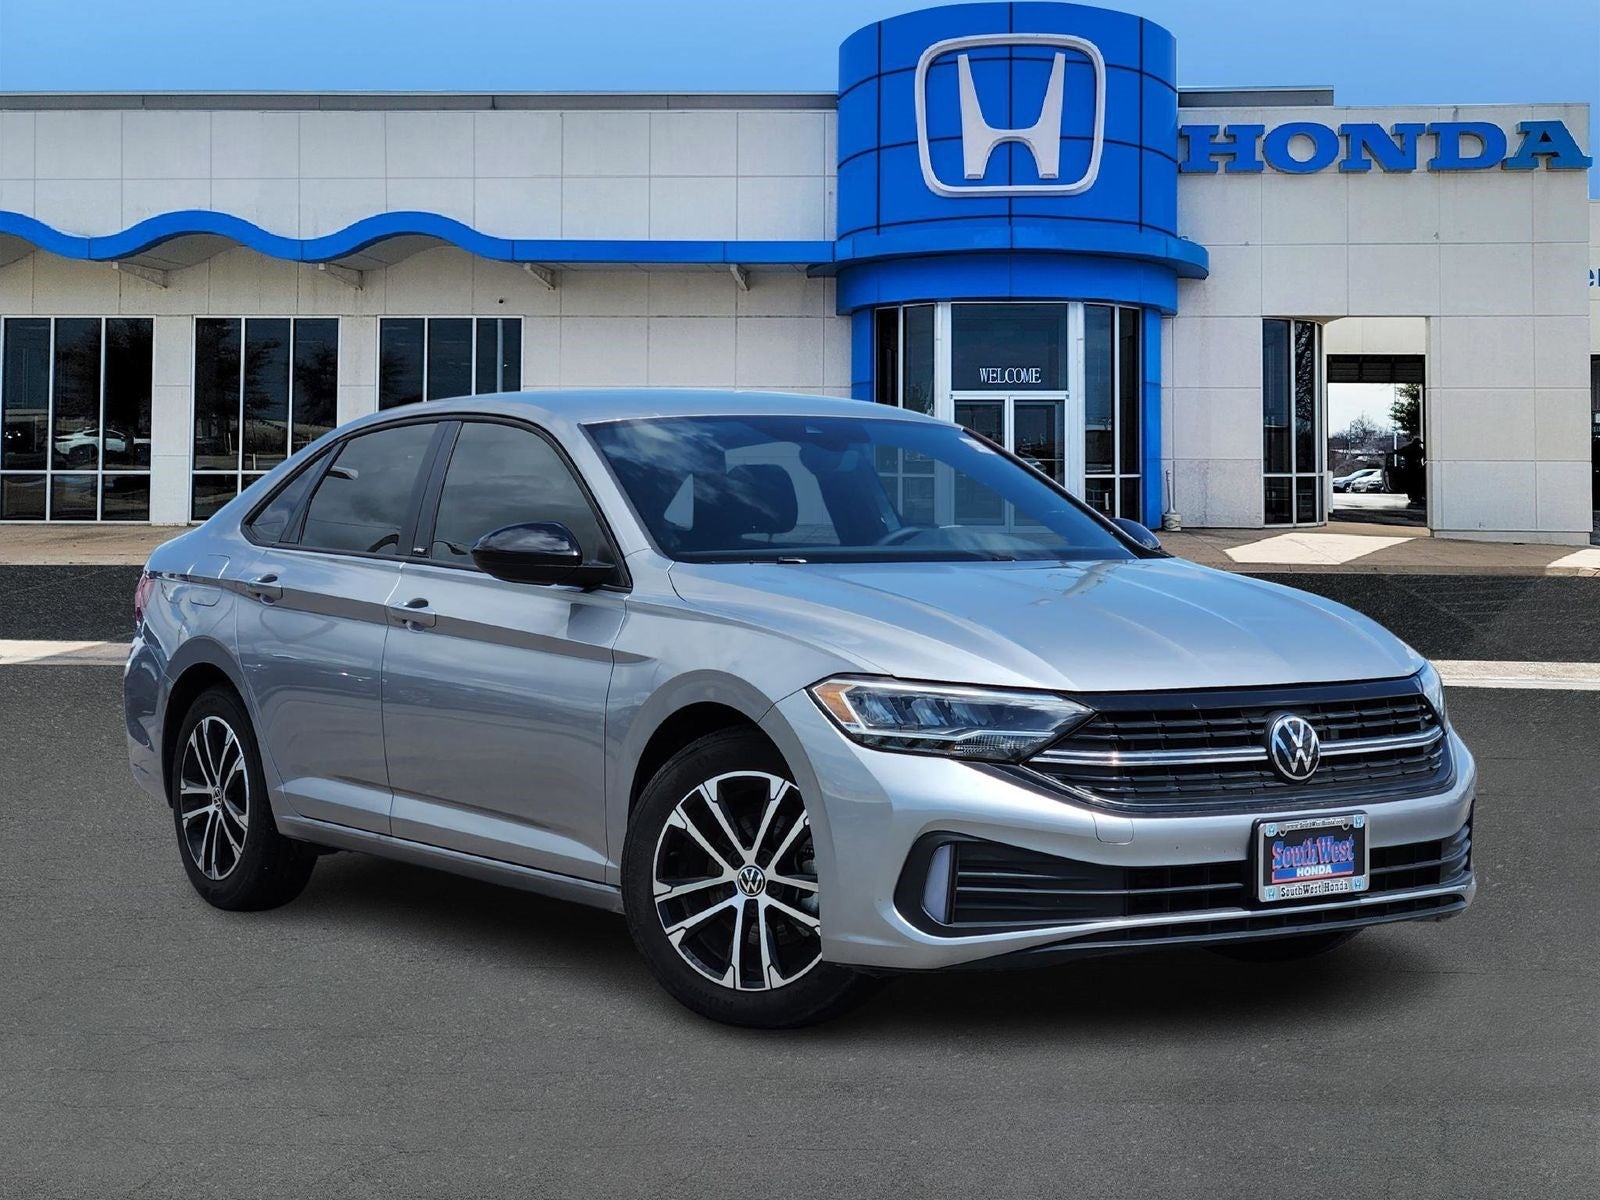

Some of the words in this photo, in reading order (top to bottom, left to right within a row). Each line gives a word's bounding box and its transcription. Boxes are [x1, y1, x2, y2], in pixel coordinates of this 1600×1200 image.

[1178, 121, 1593, 174] HONDA
[979, 367, 1042, 384] WELCOME
[1296, 864, 1333, 878] HONDA
[1280, 883, 1322, 898] SouthWest
[1324, 881, 1349, 893] Honda
